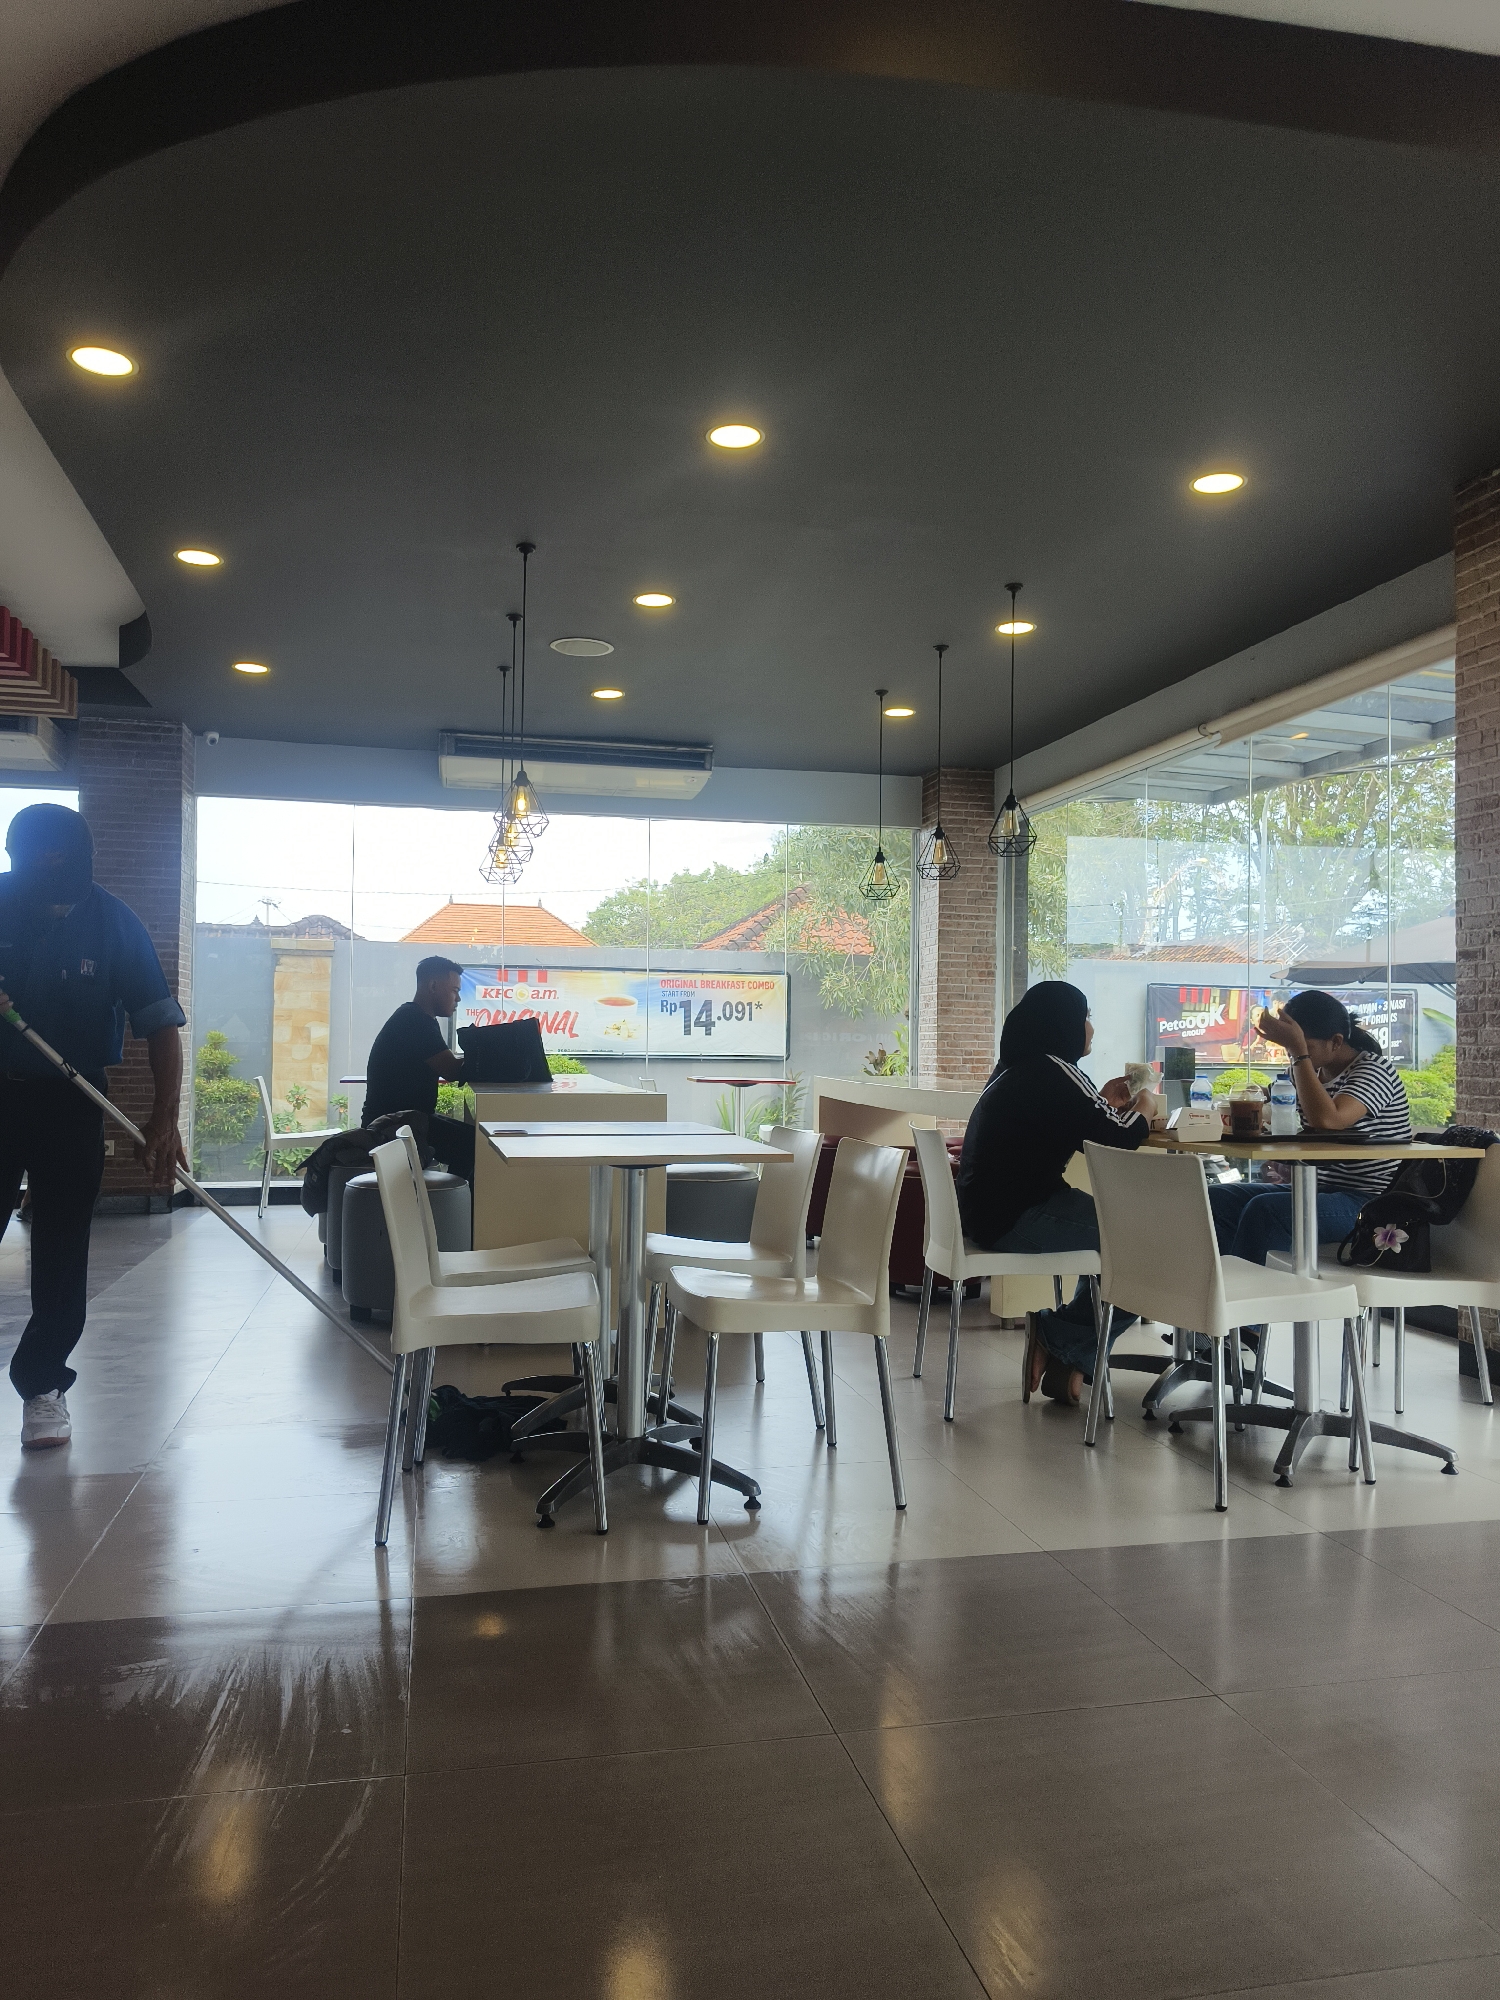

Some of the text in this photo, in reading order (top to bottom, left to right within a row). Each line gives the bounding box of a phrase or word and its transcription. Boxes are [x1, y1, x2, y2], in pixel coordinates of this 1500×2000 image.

[660, 979, 775, 990] ORIGINAL BREAKFAST COMBO
[482, 988, 514, 999] KFC
[661, 990, 696, 998] START FROM
[466, 1008, 480, 1017] THE
[1181, 1028, 1207, 1038] GROUP
